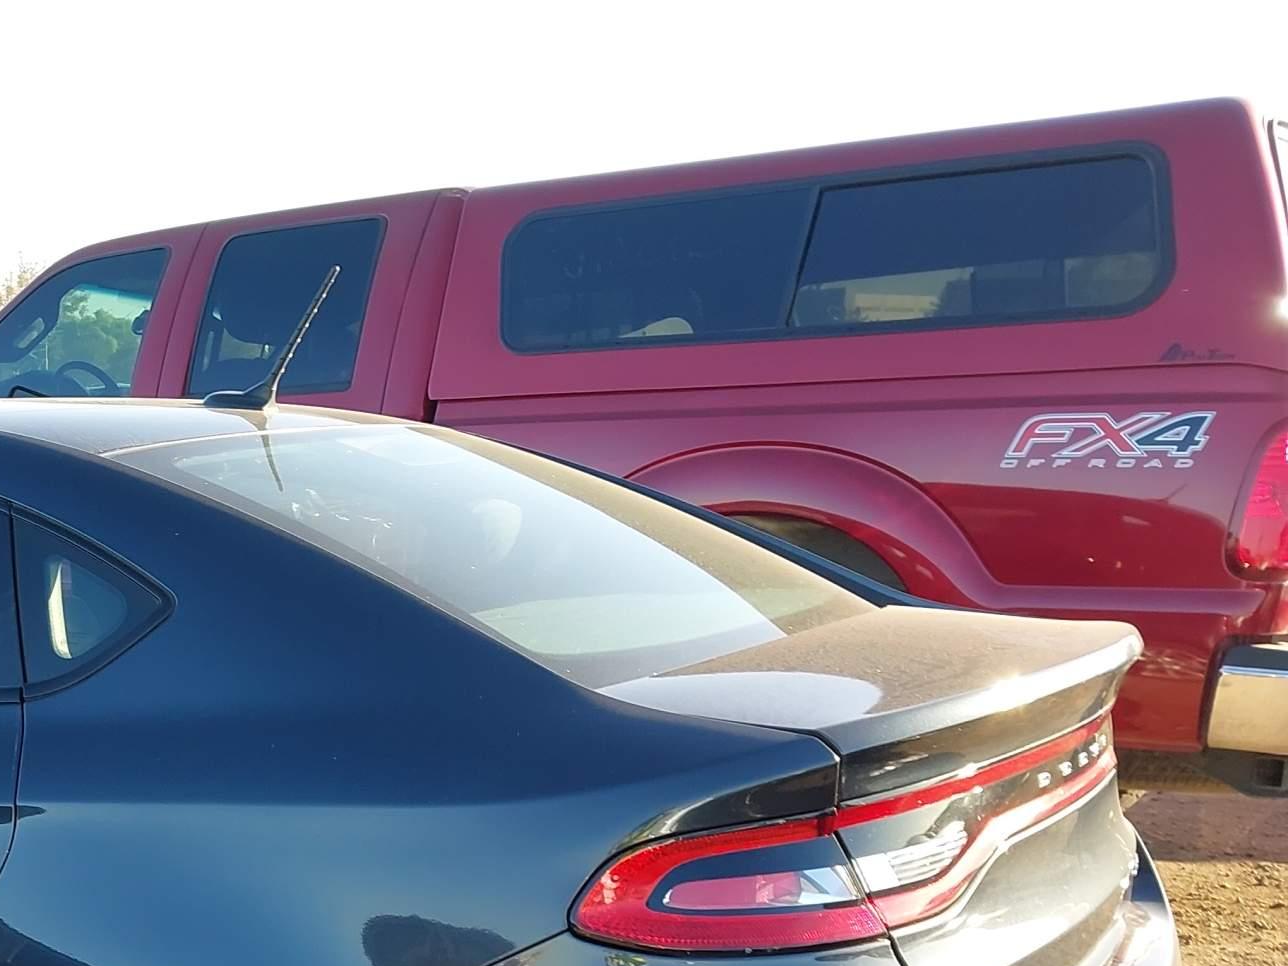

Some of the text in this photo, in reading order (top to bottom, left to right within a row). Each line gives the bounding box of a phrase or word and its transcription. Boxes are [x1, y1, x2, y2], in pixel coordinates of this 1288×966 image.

[1005, 411, 1216, 458] FX4
[1000, 458, 1195, 469] OFF ROAD
